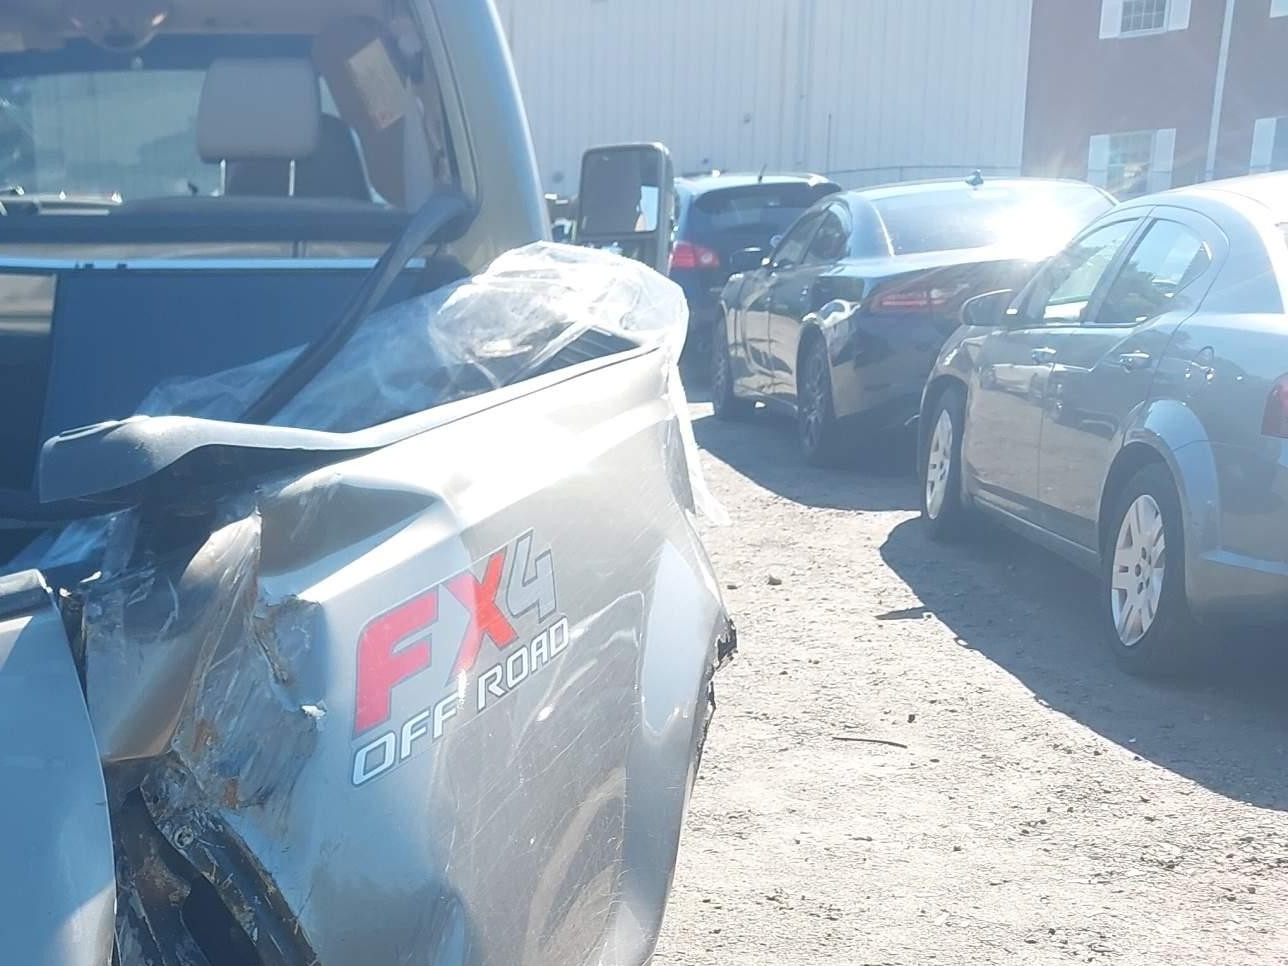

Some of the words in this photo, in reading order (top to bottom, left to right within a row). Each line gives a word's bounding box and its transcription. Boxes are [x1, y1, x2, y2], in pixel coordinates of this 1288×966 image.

[352, 526, 557, 740] FX4
[352, 690, 462, 786] OFF
[476, 615, 570, 713] ROAD
